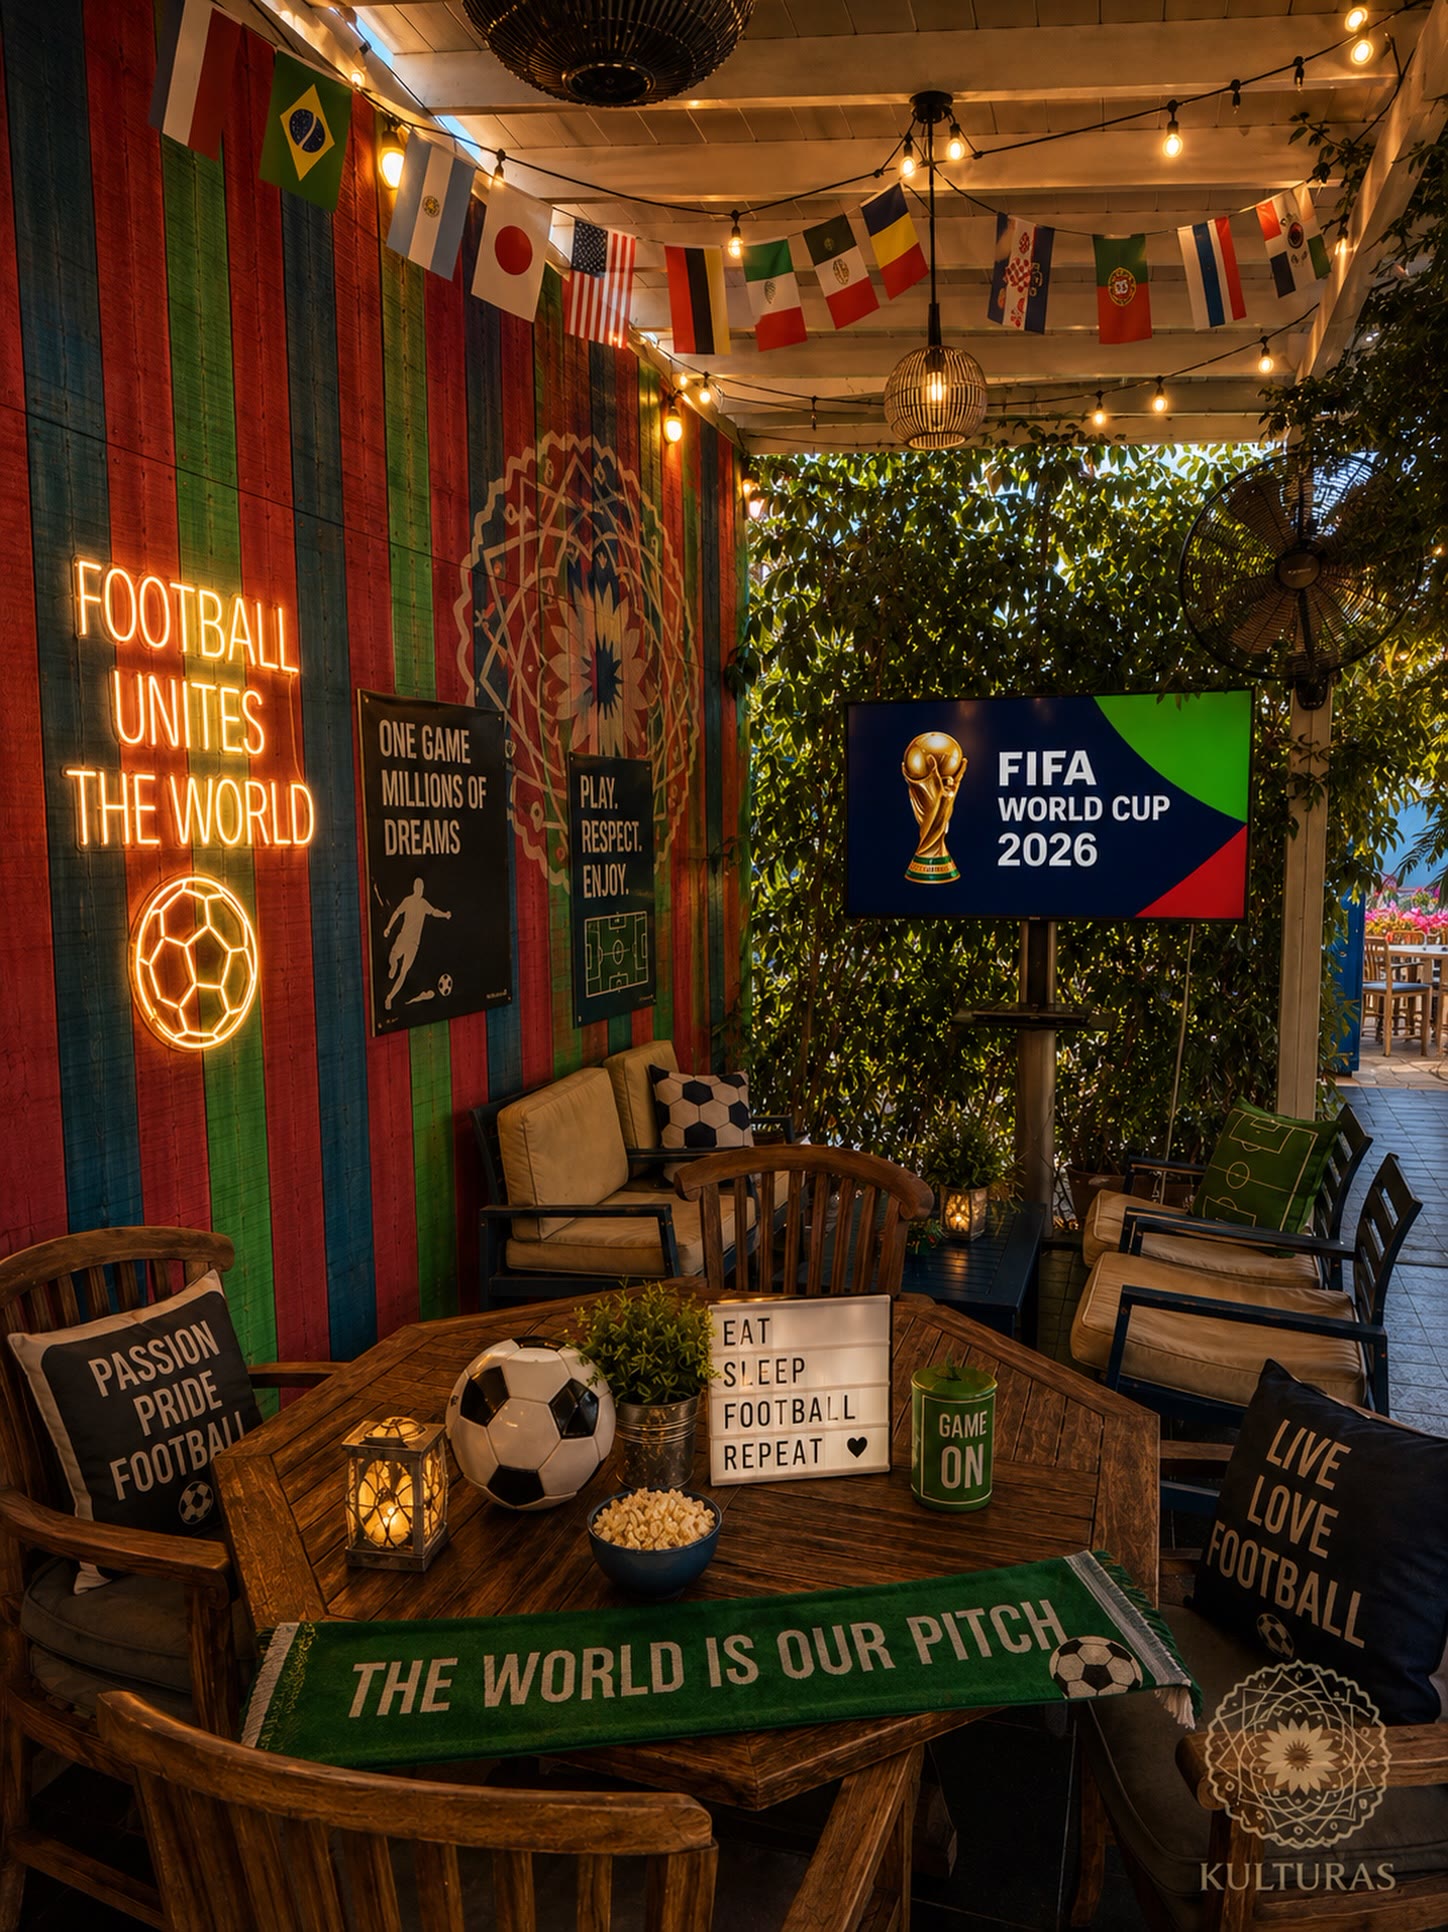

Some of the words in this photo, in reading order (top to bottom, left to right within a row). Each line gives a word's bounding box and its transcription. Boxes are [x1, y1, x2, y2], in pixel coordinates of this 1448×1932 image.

[76, 559, 300, 675] FOOTBALL
[112, 668, 266, 756] UNITES
[379, 719, 417, 759] ONE
[421, 725, 471, 764] GAME
[999, 750, 1097, 786] FIFA
[65, 768, 162, 847] THE
[168, 773, 316, 847] WORLD
[381, 769, 464, 809] MILLIONS
[467, 775, 487, 809] OF
[580, 774, 618, 810] PLAY.
[998, 796, 1103, 822] WORLD
[1111, 795, 1171, 821] CUP
[384, 818, 461, 856] DREAMS
[581, 819, 643, 854] RESPECT.
[997, 832, 1098, 867] 2026
[583, 863, 629, 899] ENJOY.
[723, 1317, 771, 1346] EAT
[88, 1320, 221, 1398] PASSION
[723, 1357, 806, 1387] SLEEP
[133, 1369, 223, 1437] PRIDE
[724, 1394, 856, 1430] FOOTBALL
[938, 1410, 988, 1439] GAME
[724, 1438, 823, 1471] REPEAT
[940, 1445, 984, 1489] ON
[1265, 1418, 1352, 1491] LIVE
[1247, 1475, 1339, 1559] LOVE
[1206, 1520, 1365, 1649] FOOTBALL
[349, 1657, 459, 1718] THE
[483, 1641, 685, 1708] WORLD
[705, 1634, 759, 1688] IS
[776, 1622, 896, 1680] OUR
[906, 1600, 1069, 1665] PITCH
